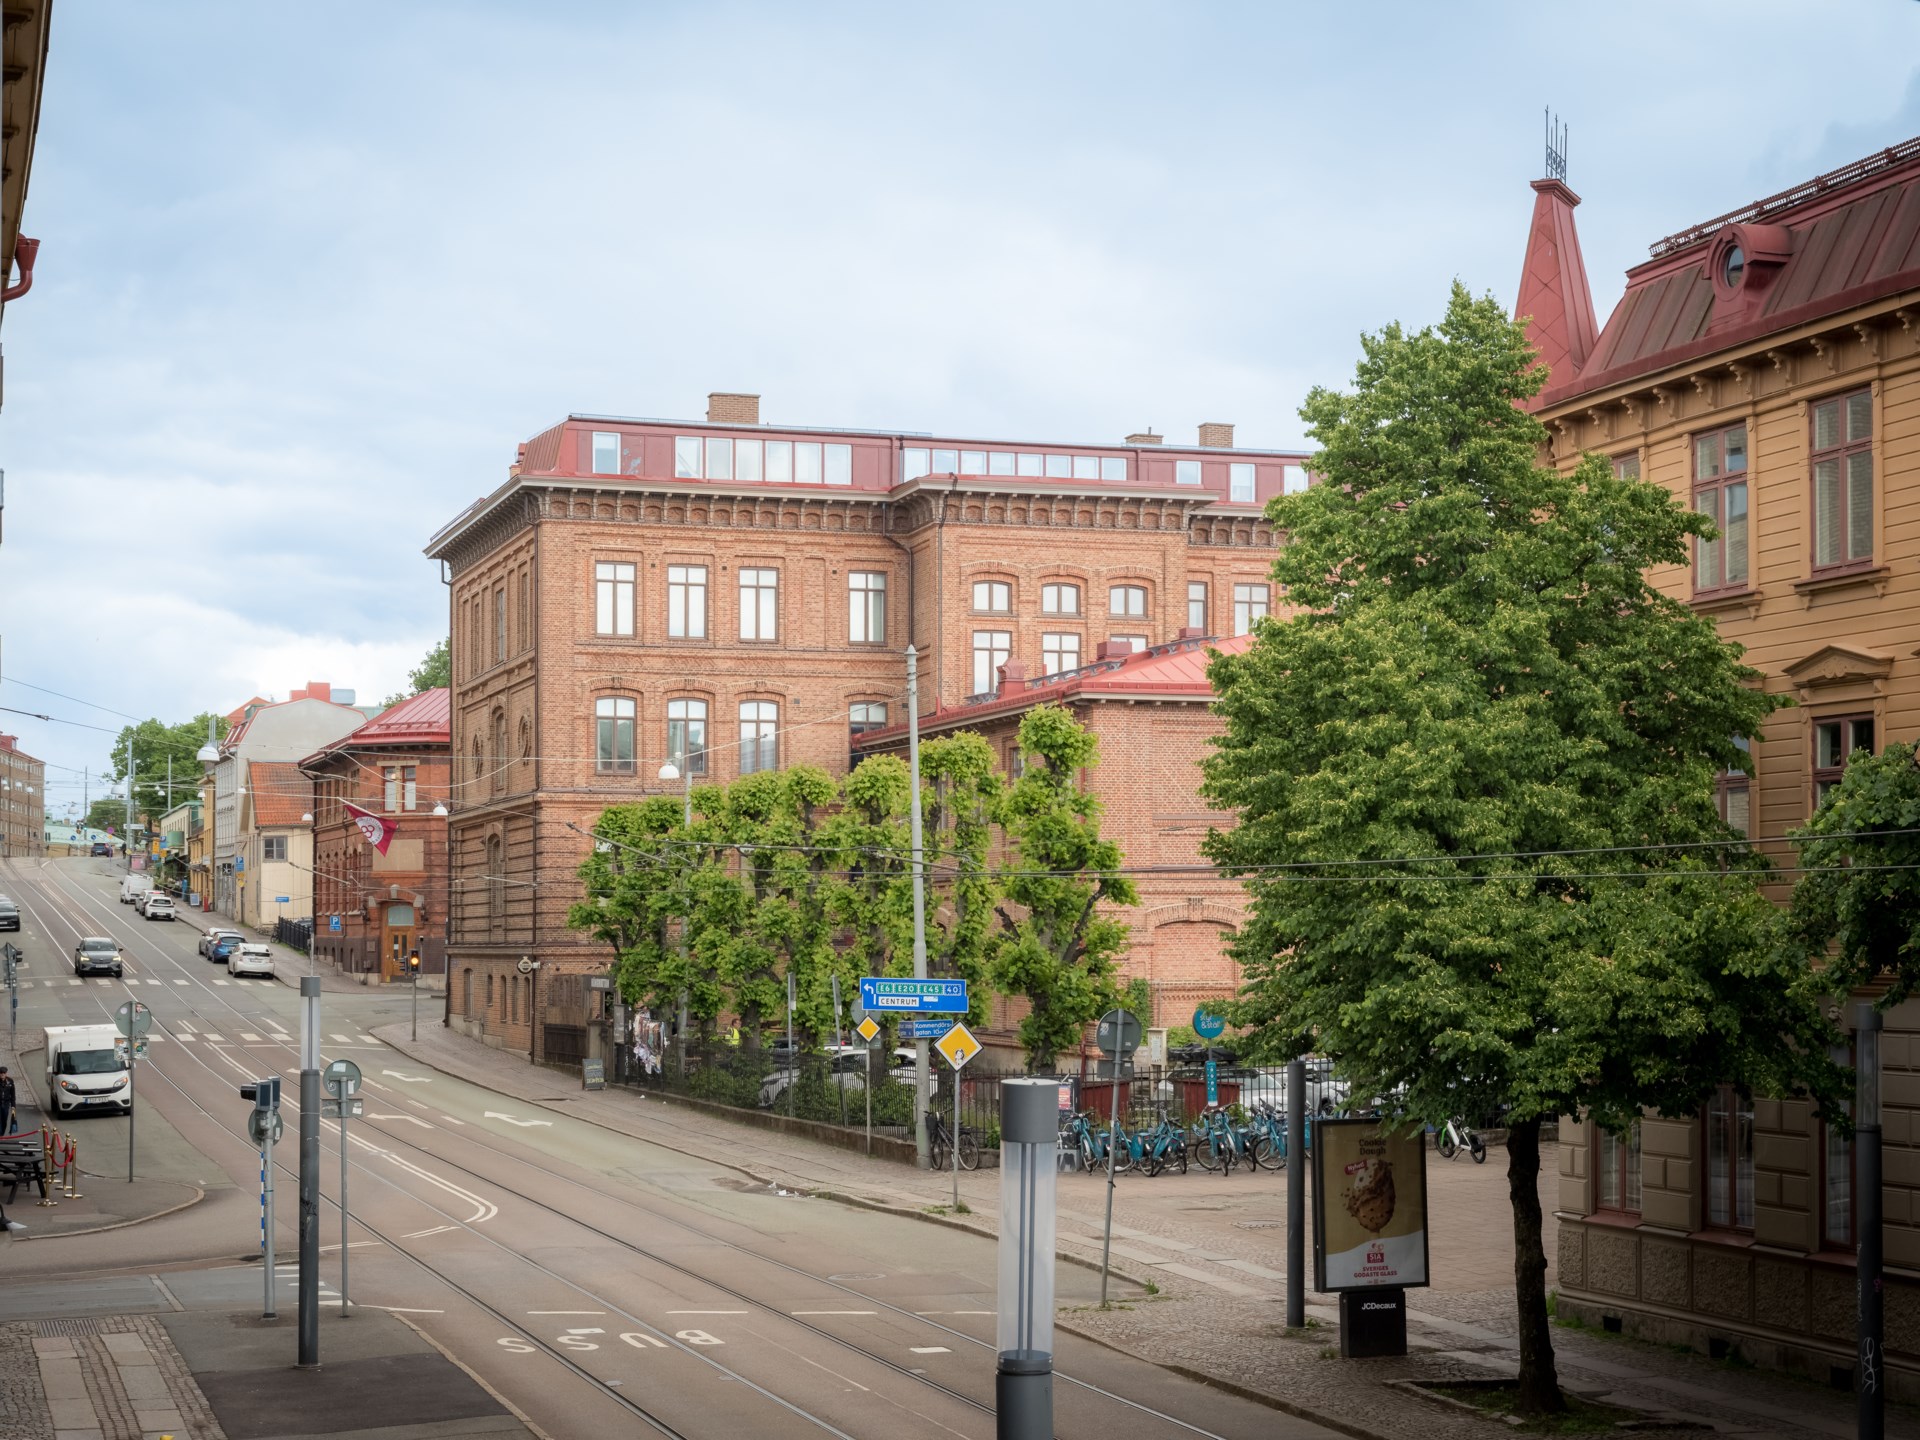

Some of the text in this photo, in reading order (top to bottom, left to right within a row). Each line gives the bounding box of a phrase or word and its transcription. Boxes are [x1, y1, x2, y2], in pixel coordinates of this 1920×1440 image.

[1359, 1138, 1386, 1147] Cookie
[1360, 1147, 1386, 1156] Dough
[1362, 1302, 1396, 1310] JCDecaux
